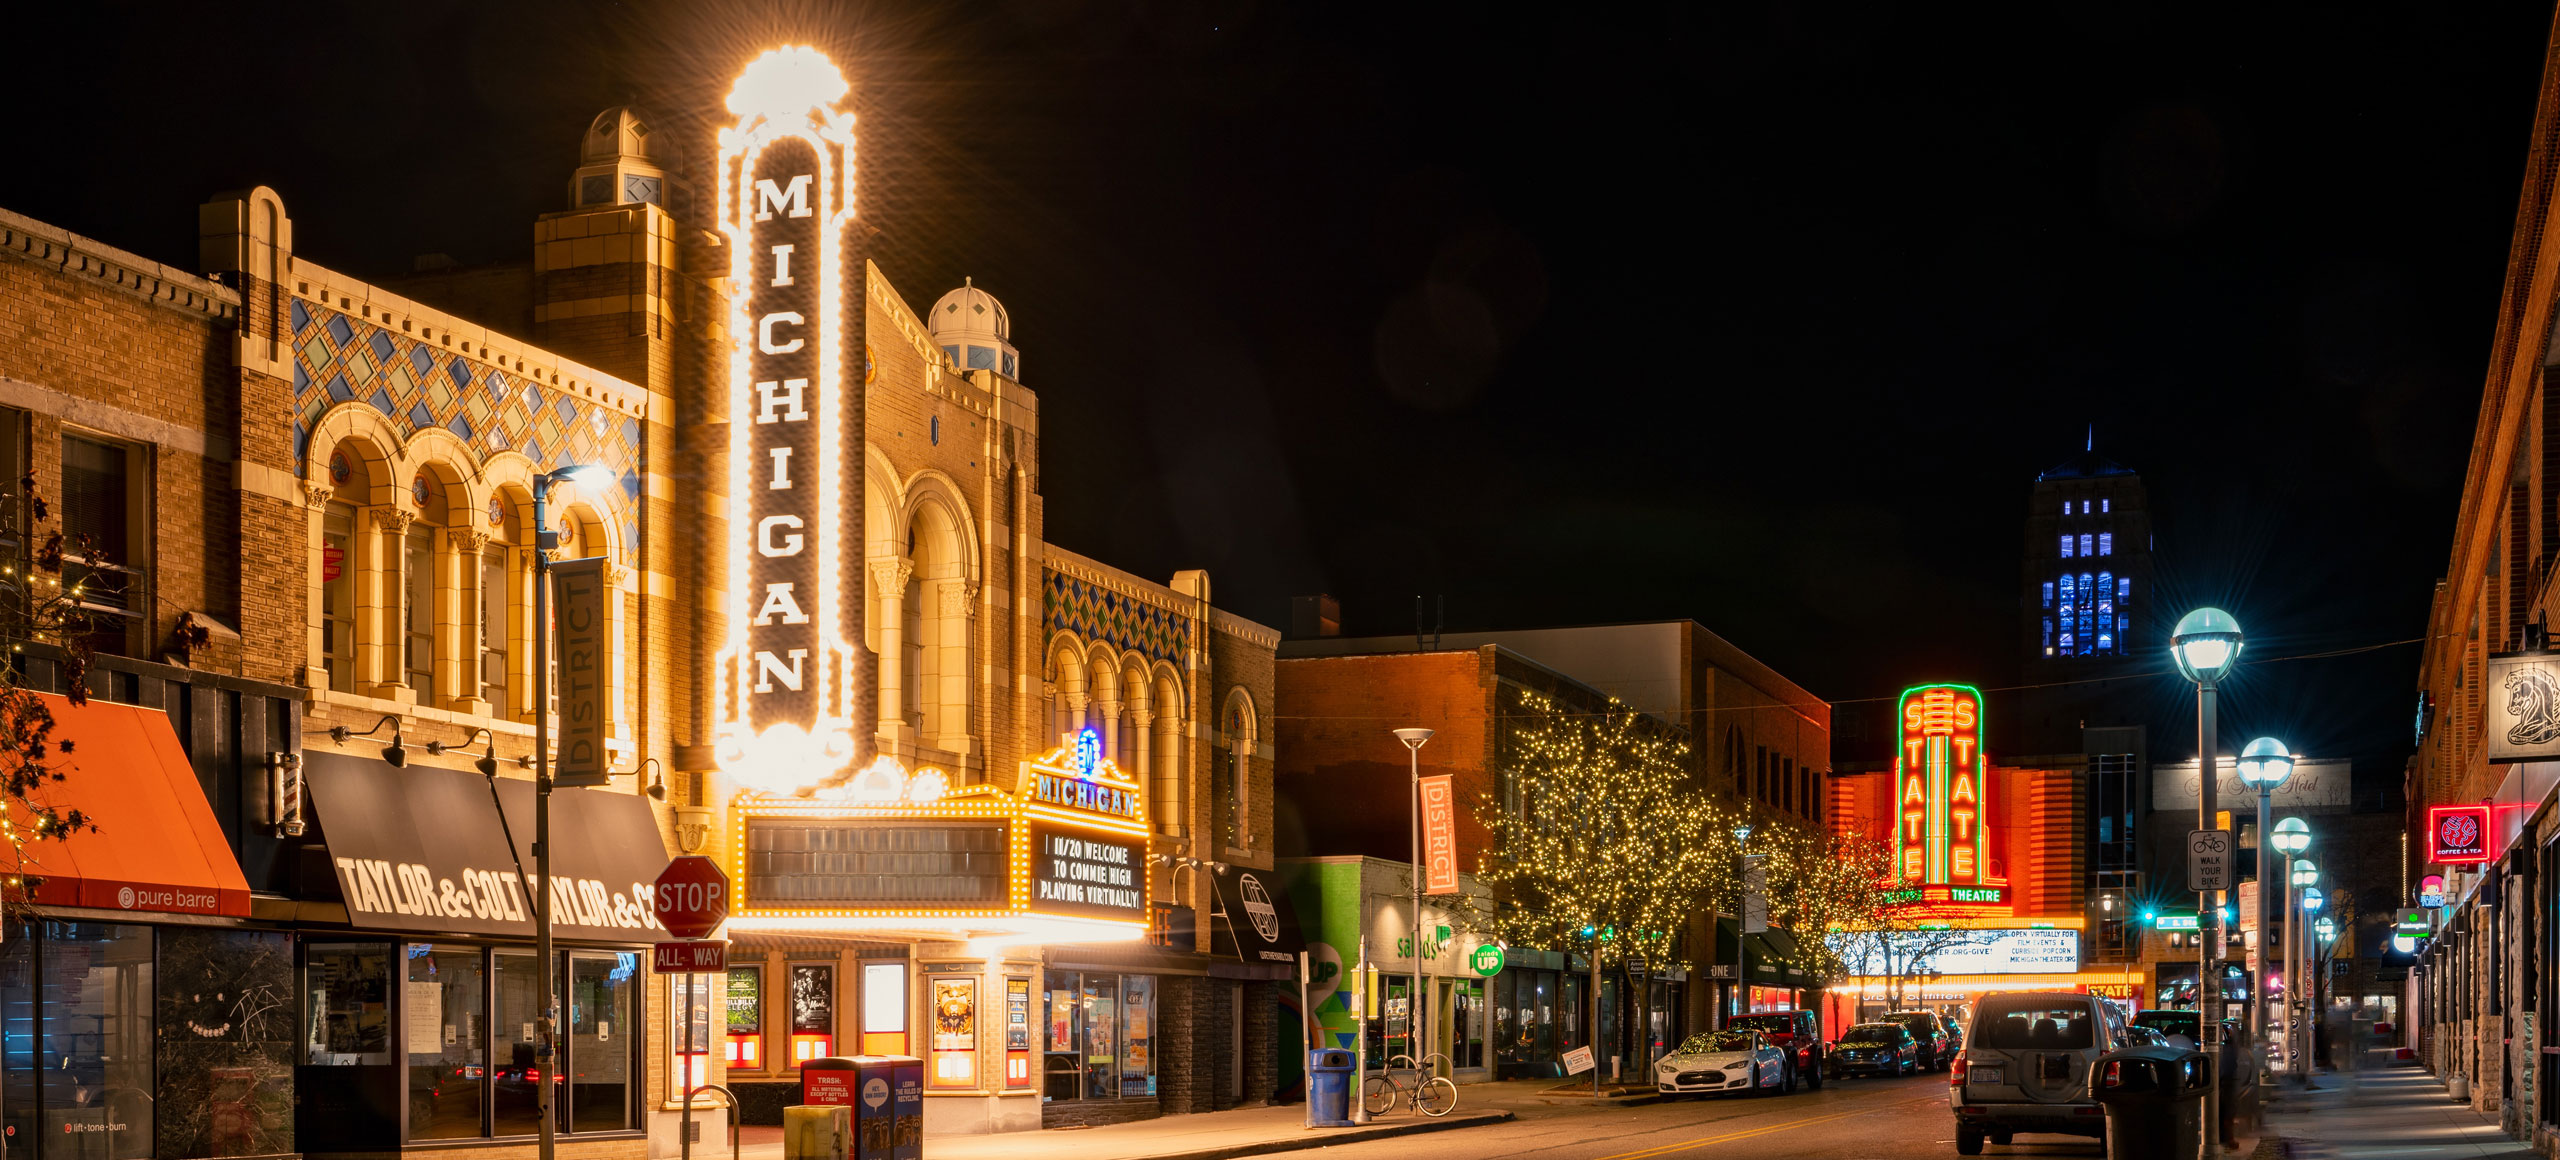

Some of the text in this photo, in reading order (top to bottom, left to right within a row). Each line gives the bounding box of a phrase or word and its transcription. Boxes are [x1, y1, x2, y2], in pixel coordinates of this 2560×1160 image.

[754, 174, 813, 694] MICHIGAN
[566, 582, 592, 764] DISTRICT
[1036, 775, 1135, 818] MICHIGAN
[1904, 701, 1924, 877] STATE
[1952, 701, 1975, 877] STATE
[1429, 787, 1450, 883] DISTRICT
[1054, 836, 1128, 864] 11/20 WELCOME
[2200, 856, 2220, 865] WALK
[2200, 866, 2221, 875] YOUR
[1054, 860, 1067, 878] TO
[1109, 866, 1131, 886] HIGH
[2201, 877, 2220, 886] BIKE
[138, 890, 173, 908] pure
[176, 889, 216, 908] barre
[658, 882, 721, 912] STOP
[1040, 879, 1138, 909] PLAYING VIRTUALLY
[1952, 889, 2000, 902] THEATRE
[1397, 931, 1437, 960] salds
[2042, 947, 2072, 955] POPCORN
[657, 947, 721, 967] ALL WAY
[1477, 956, 1500, 970] UP
[1710, 965, 1729, 977] ONE
[2089, 985, 2132, 997] STATE
[817, 1077, 842, 1085] TRASH:
[73, 1123, 126, 1132] lift tone burn
